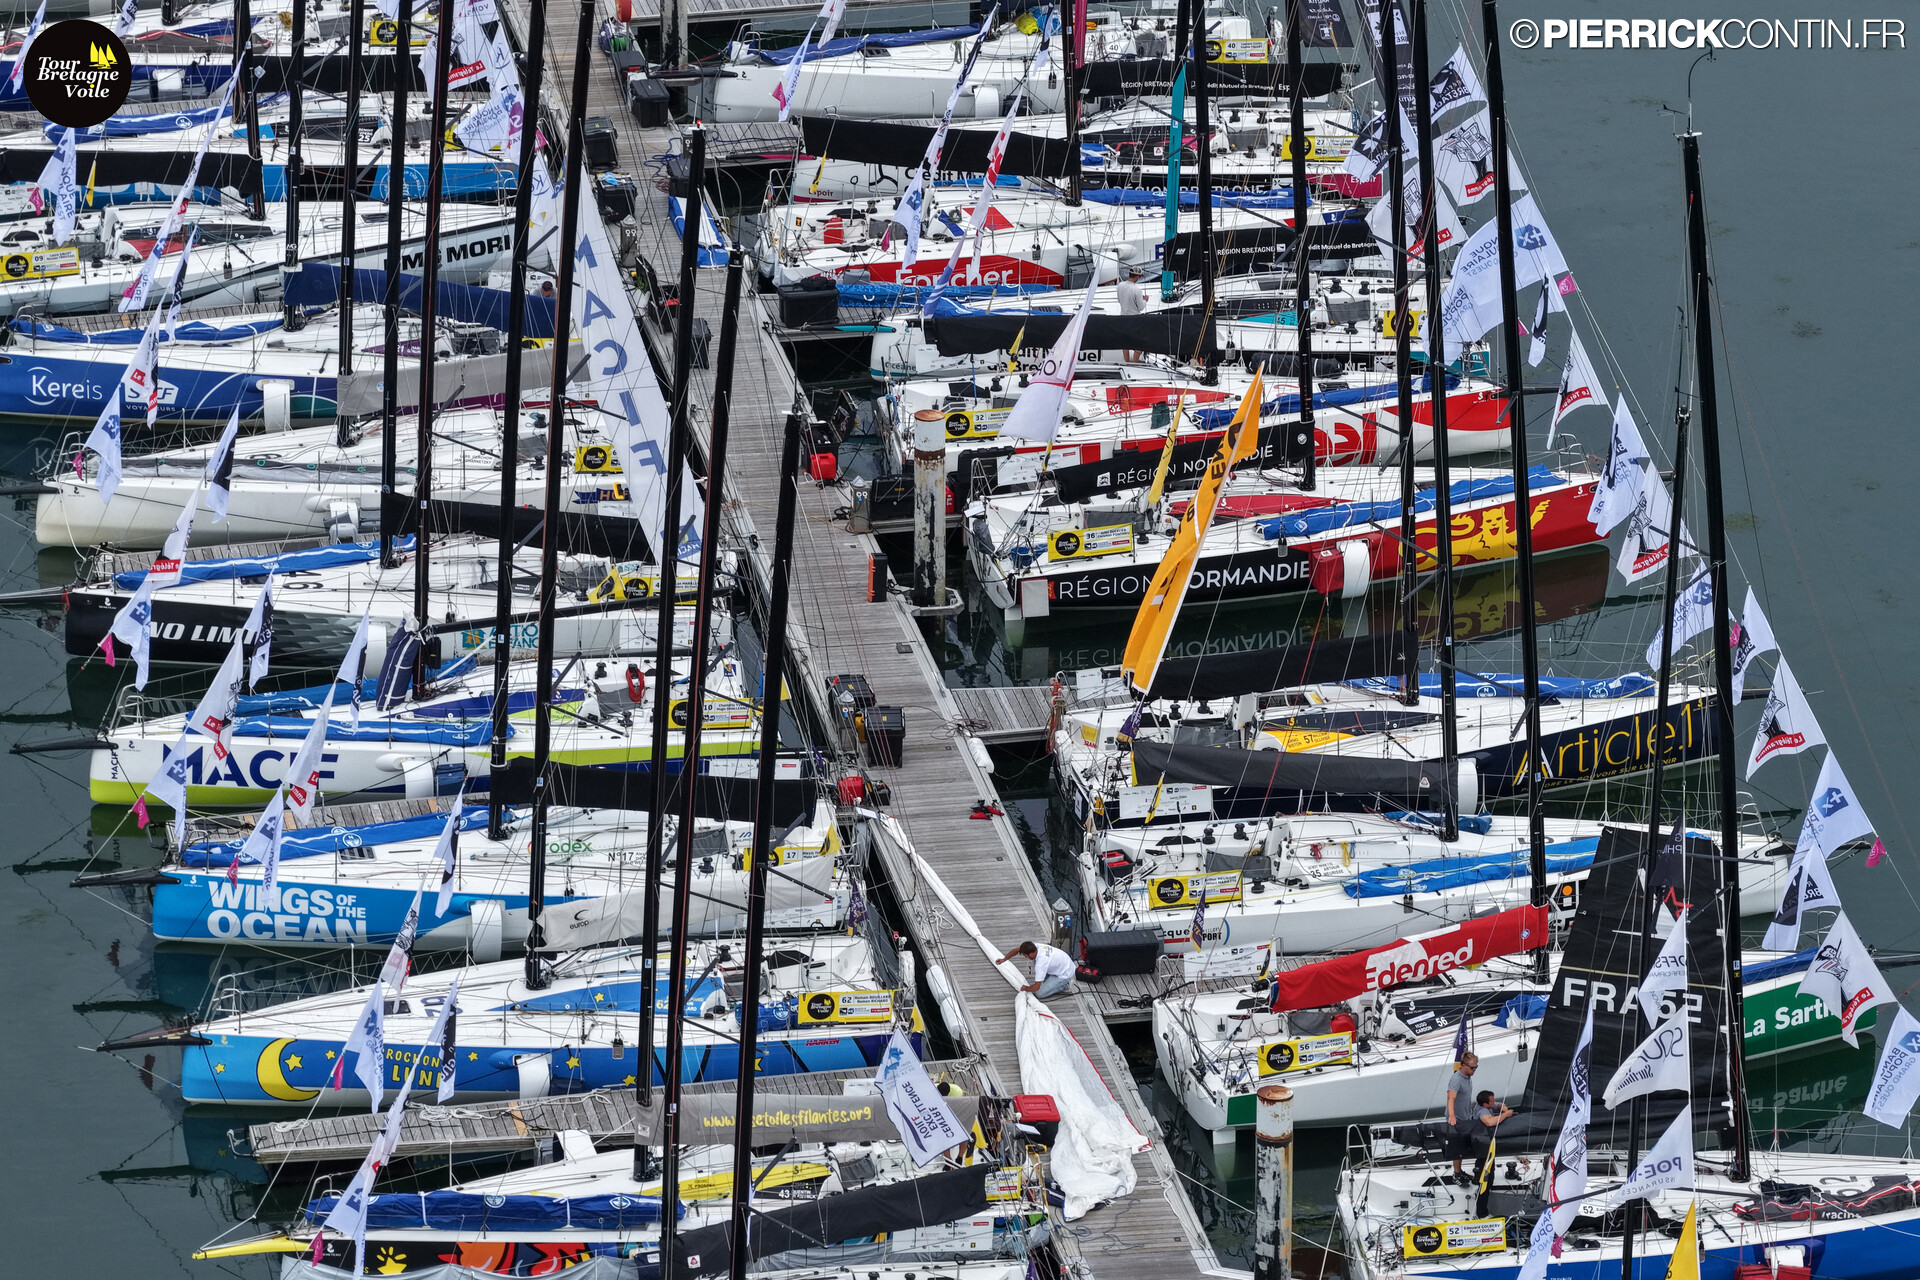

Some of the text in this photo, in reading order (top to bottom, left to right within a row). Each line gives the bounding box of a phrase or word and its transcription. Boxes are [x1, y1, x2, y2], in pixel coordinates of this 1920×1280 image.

[446, 235, 511, 263] MORI
[31, 373, 103, 400] Kereis
[1109, 404, 1122, 413] 32
[1117, 464, 1177, 485] RÉGIN
[1189, 558, 1310, 590] ORMANDIE
[150, 621, 186, 641] NO
[703, 703, 713, 711] 10
[1303, 734, 1314, 744] 57
[111, 751, 119, 780] MACIF
[1619, 765, 1637, 774] SUR
[1639, 757, 1677, 770] L'AVNIR
[1310, 869, 1322, 879] 35
[1190, 879, 1200, 887] 35
[208, 881, 357, 914] WINGS OF
[338, 907, 366, 919] THE
[207, 909, 367, 944] OCEAN
[1365, 939, 1474, 992] Edenred
[656, 1000, 669, 1009] 62
[1435, 1016, 1448, 1027] 56
[805, 1038, 840, 1046] HARKEN
[386, 1048, 441, 1068] ROCHON
[392, 1064, 444, 1088] LUN
[779, 1189, 790, 1198] 43
[1582, 1205, 1595, 1215] 52
[1449, 1227, 1460, 1235] 52
